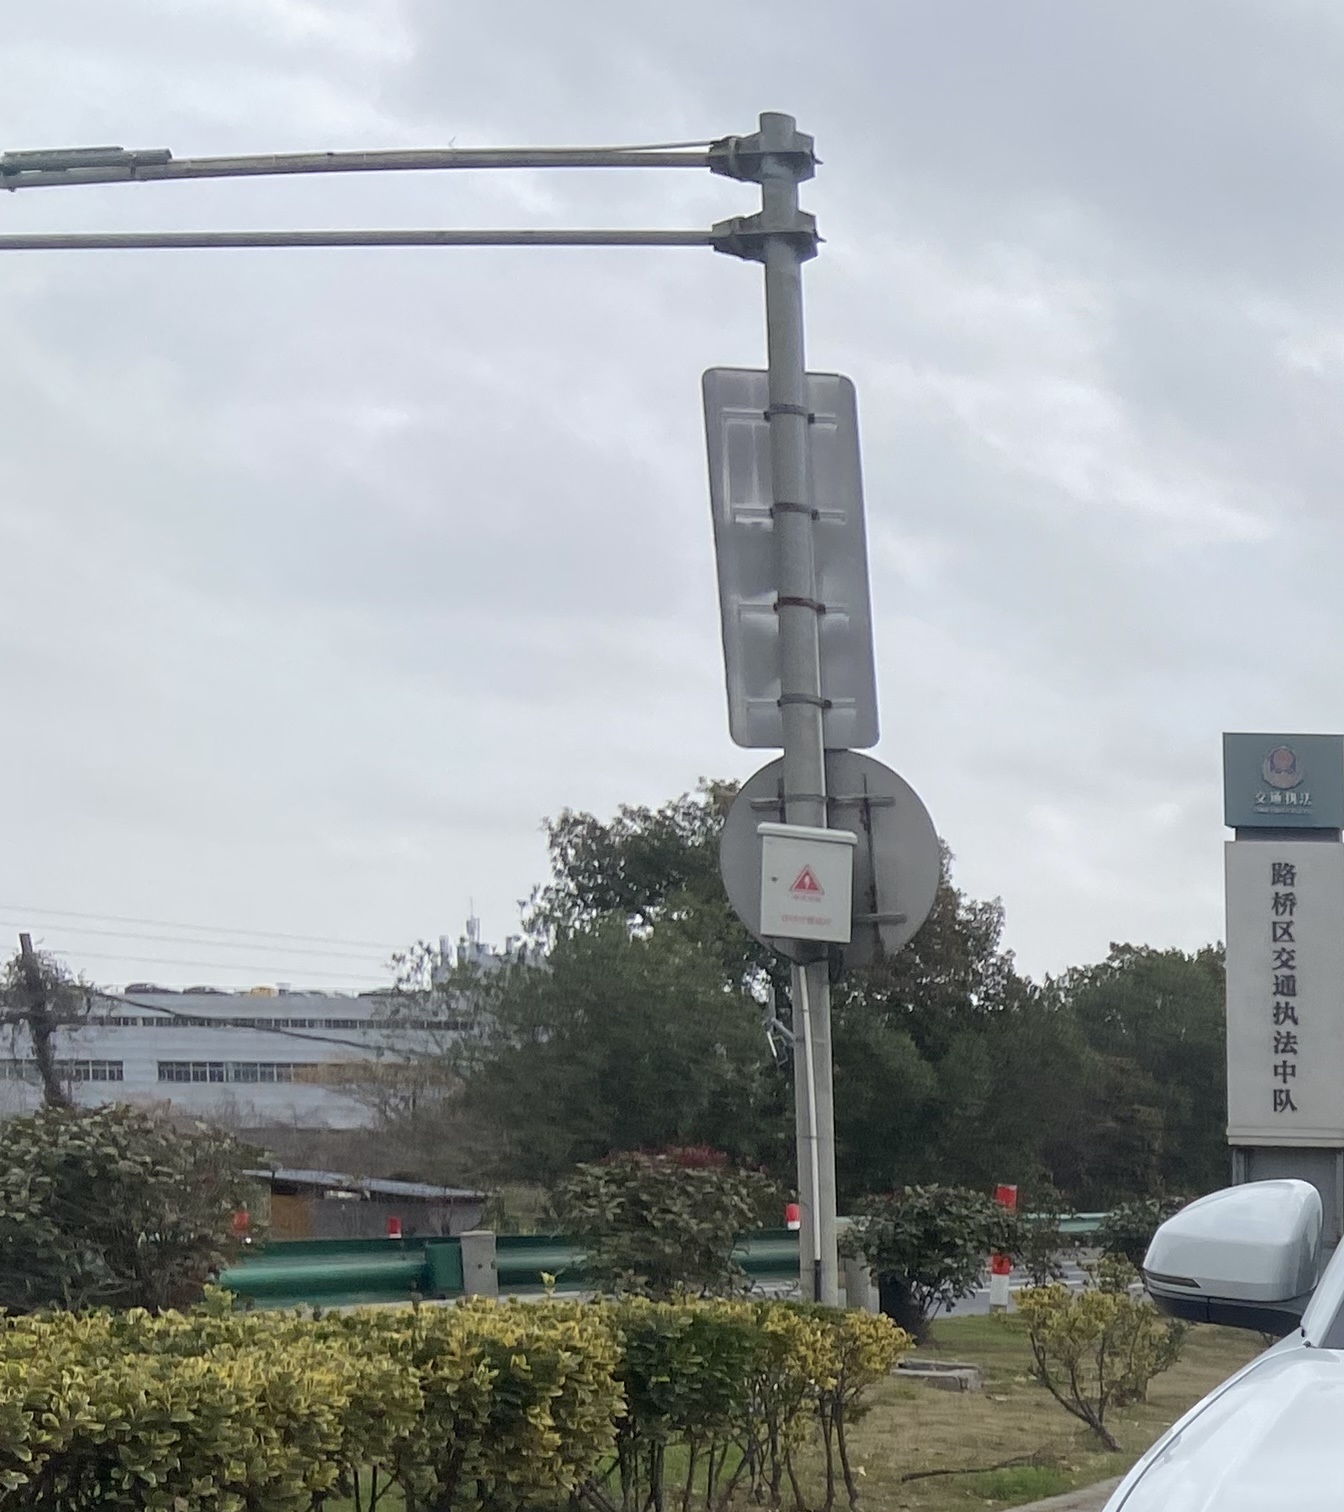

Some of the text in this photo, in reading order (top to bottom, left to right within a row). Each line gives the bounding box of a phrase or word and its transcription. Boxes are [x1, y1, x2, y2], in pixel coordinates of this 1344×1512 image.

[1271, 862, 1298, 1113] 路桥区交通执法中队
